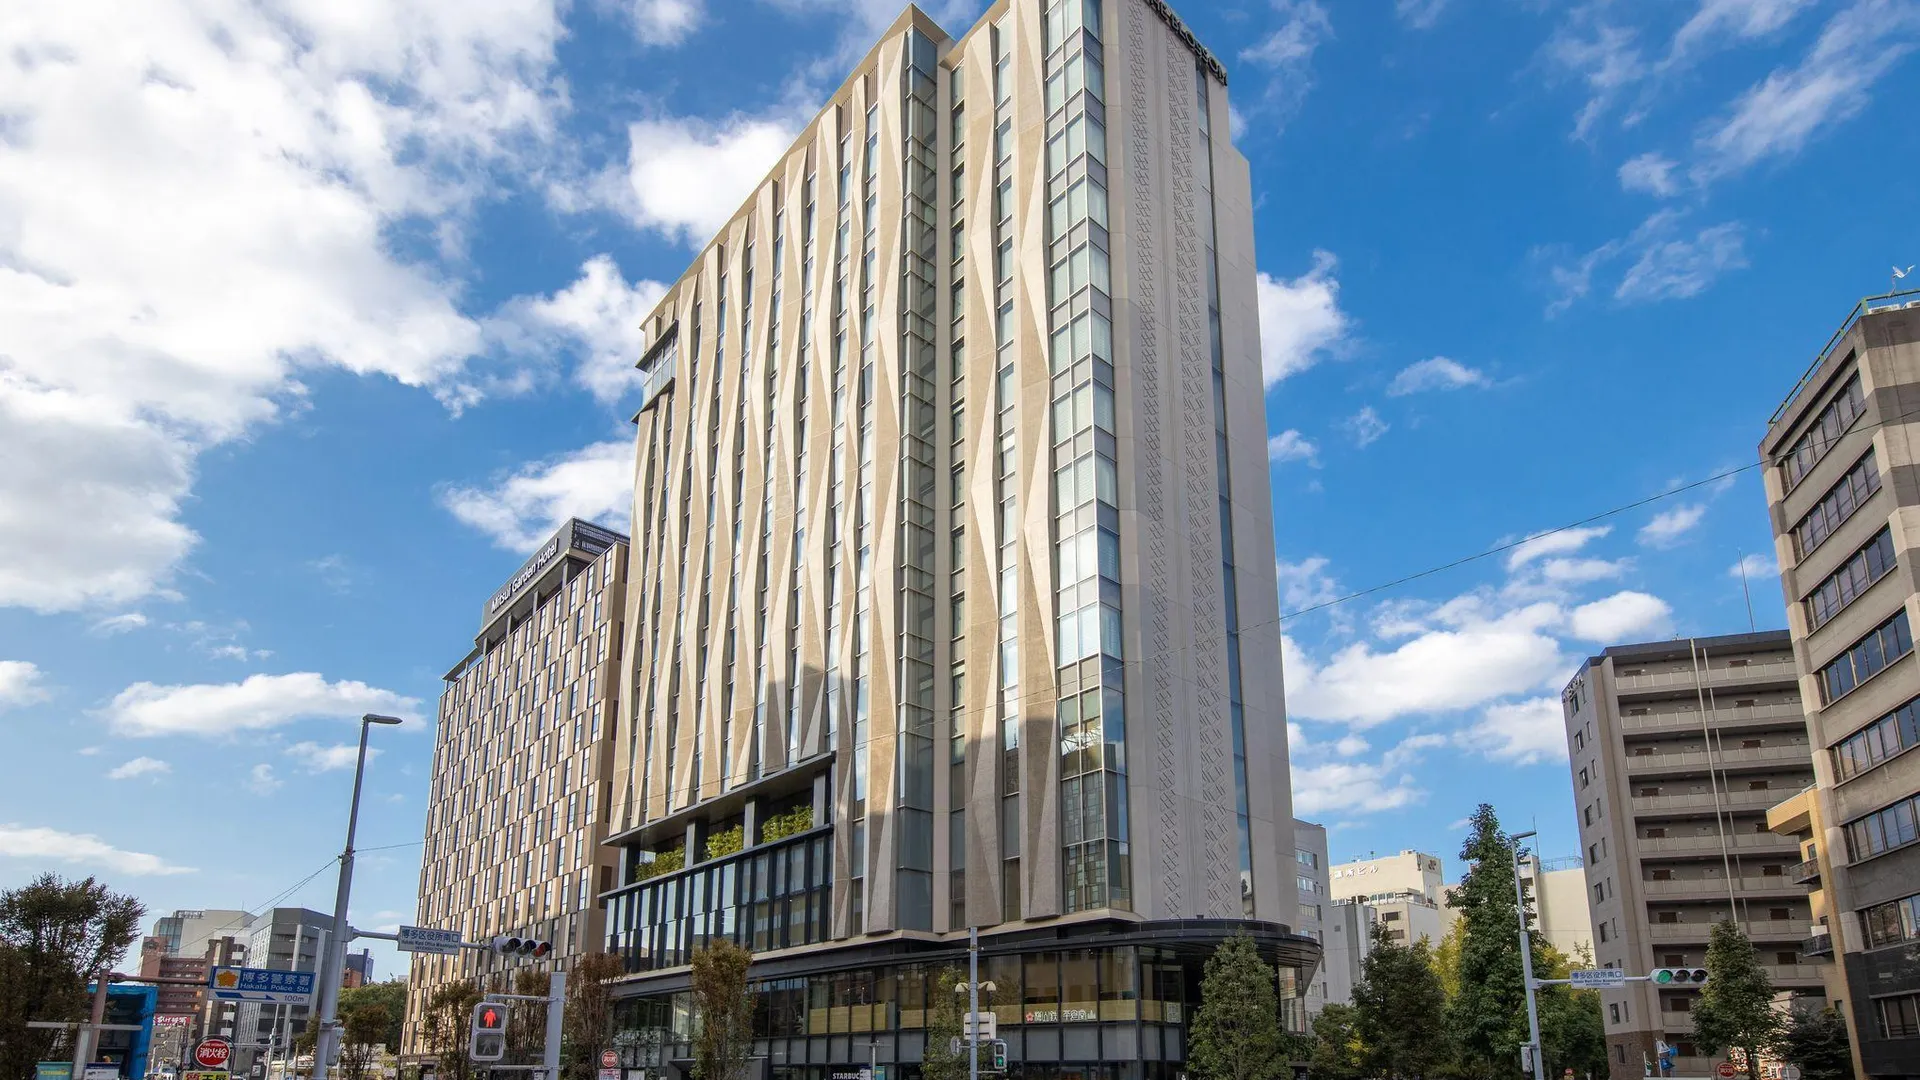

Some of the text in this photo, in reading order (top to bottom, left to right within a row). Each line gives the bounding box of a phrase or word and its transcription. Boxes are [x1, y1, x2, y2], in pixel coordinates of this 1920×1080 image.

[1170, 14, 1228, 87] BLOSSOM
[491, 583, 512, 613] Mitsui
[512, 563, 536, 592] Garden
[537, 538, 559, 570] Hotel
[402, 929, 459, 942] 博多区役所南口
[242, 971, 311, 986] 博多警察署
[270, 984, 293, 992] Police
[296, 985, 309, 993] Sta
[284, 994, 305, 1002] 100m
[199, 1047, 228, 1059] 消火栓
[832, 1072, 860, 1080] STARBUC
